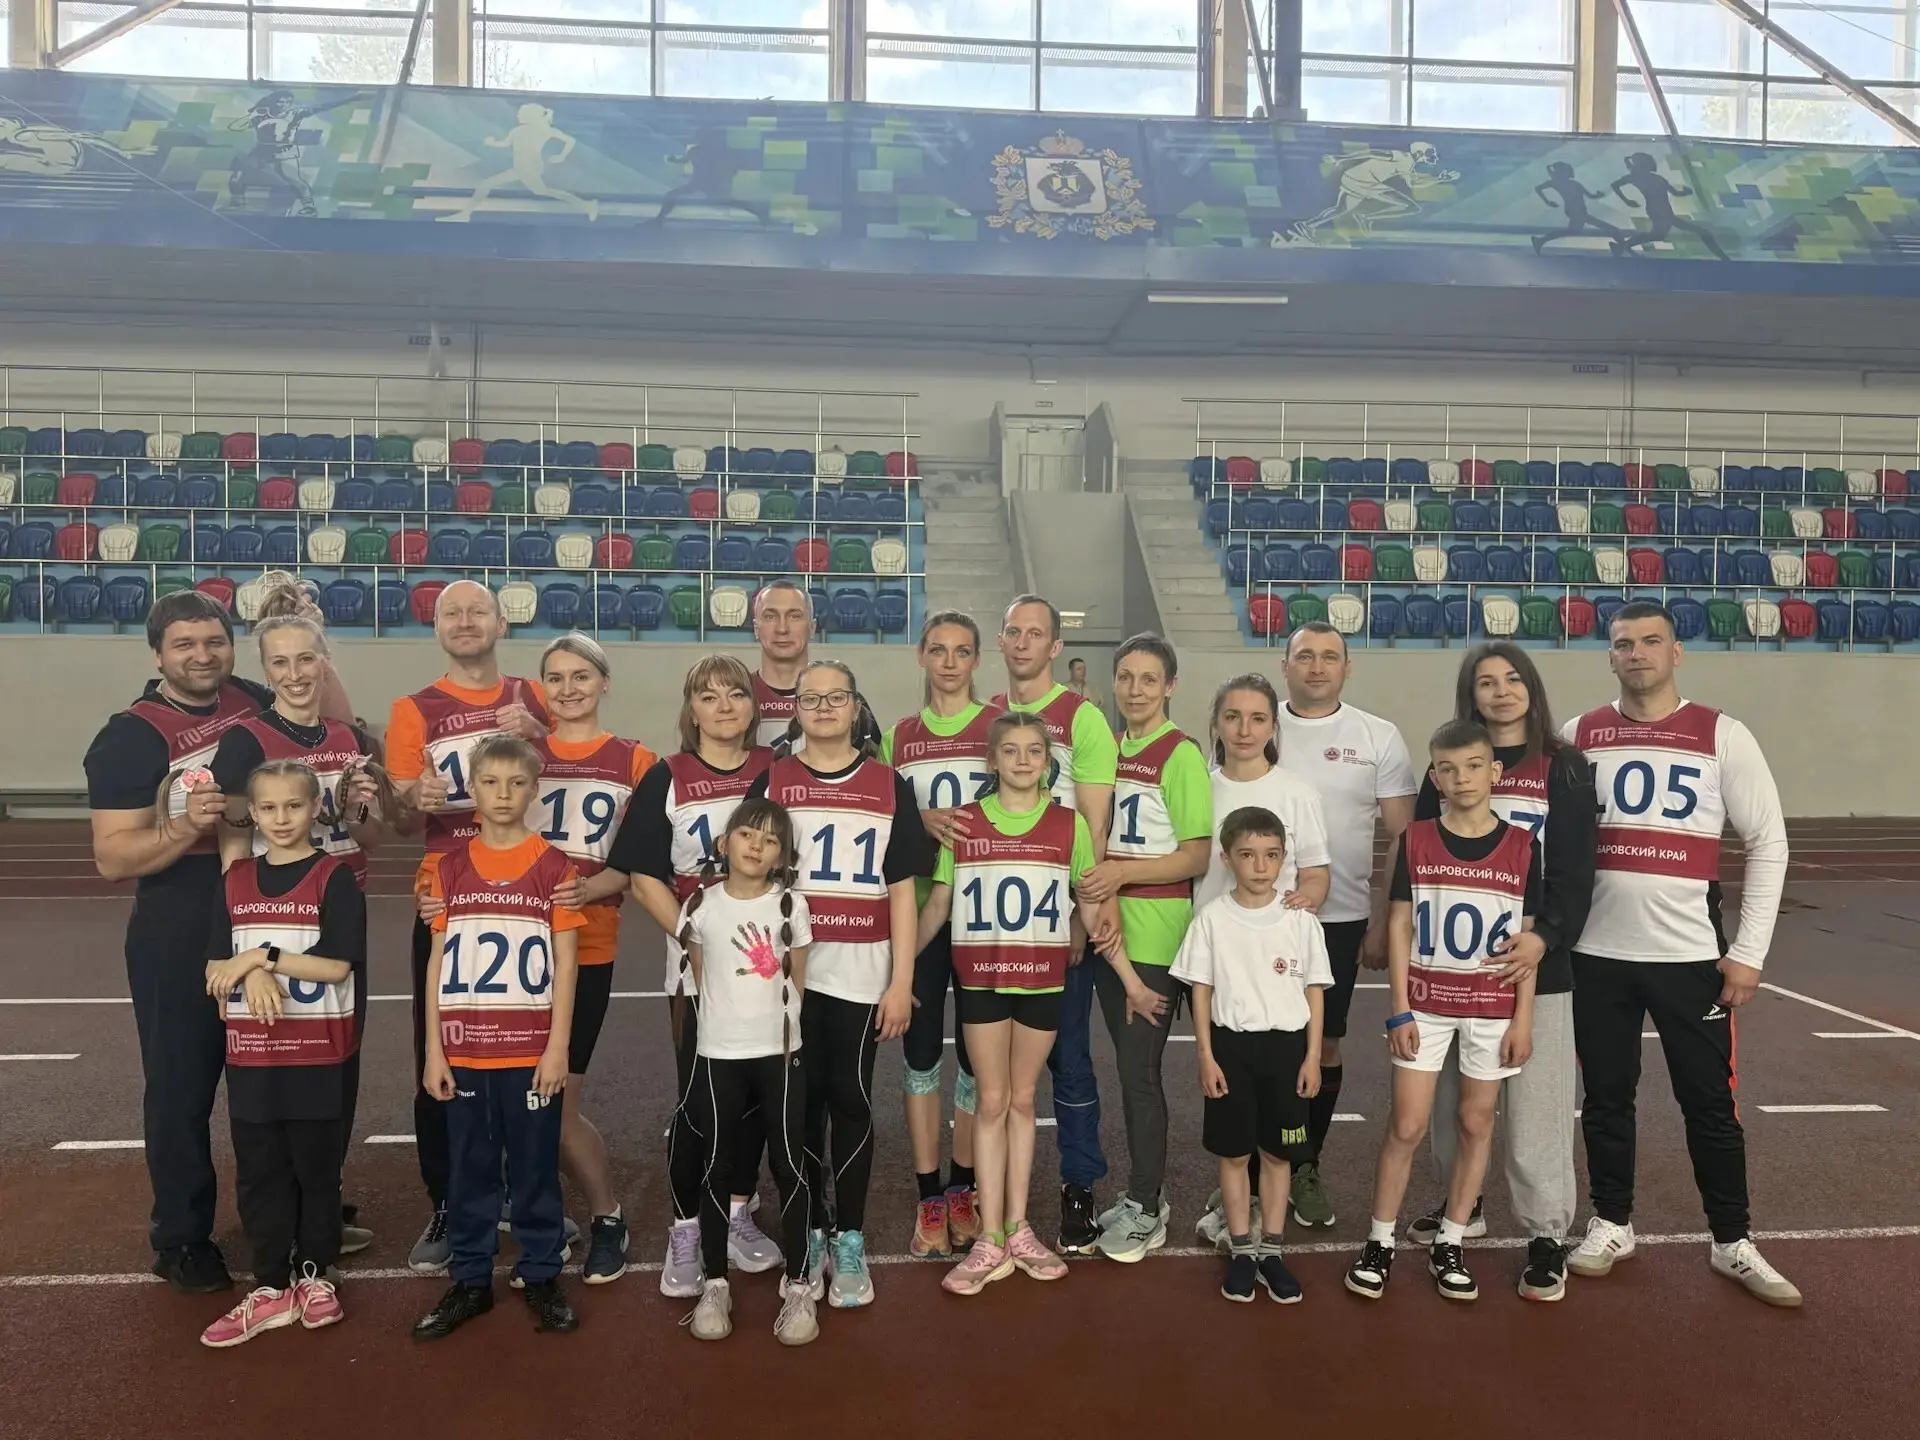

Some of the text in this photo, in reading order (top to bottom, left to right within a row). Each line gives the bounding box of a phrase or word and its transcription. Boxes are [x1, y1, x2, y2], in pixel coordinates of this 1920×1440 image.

[1044, 724, 1064, 734] РАЙ
[1590, 727, 1616, 744] ГТО
[904, 741, 925, 758] ГТО
[1343, 748, 1356, 756] ГТО
[1136, 764, 1157, 776] КРАЙ
[686, 780, 713, 796] ГТО
[906, 771, 996, 809] 07
[1517, 779, 1545, 789] КРАЙ
[782, 785, 807, 803] ГТО
[966, 838, 990, 857] ГТО
[1596, 844, 1687, 862] БАРОВСКИЙ КРАЙ
[1495, 871, 1520, 886] КРАЙ
[233, 901, 320, 915] АБАРОВСКИЙ КРА
[962, 876, 1060, 932] 104
[849, 915, 874, 926] КРАЙ
[1416, 900, 1512, 960] 106
[441, 931, 551, 995] 120
[973, 961, 1034, 973] ХАБАРОВСКИЙ
